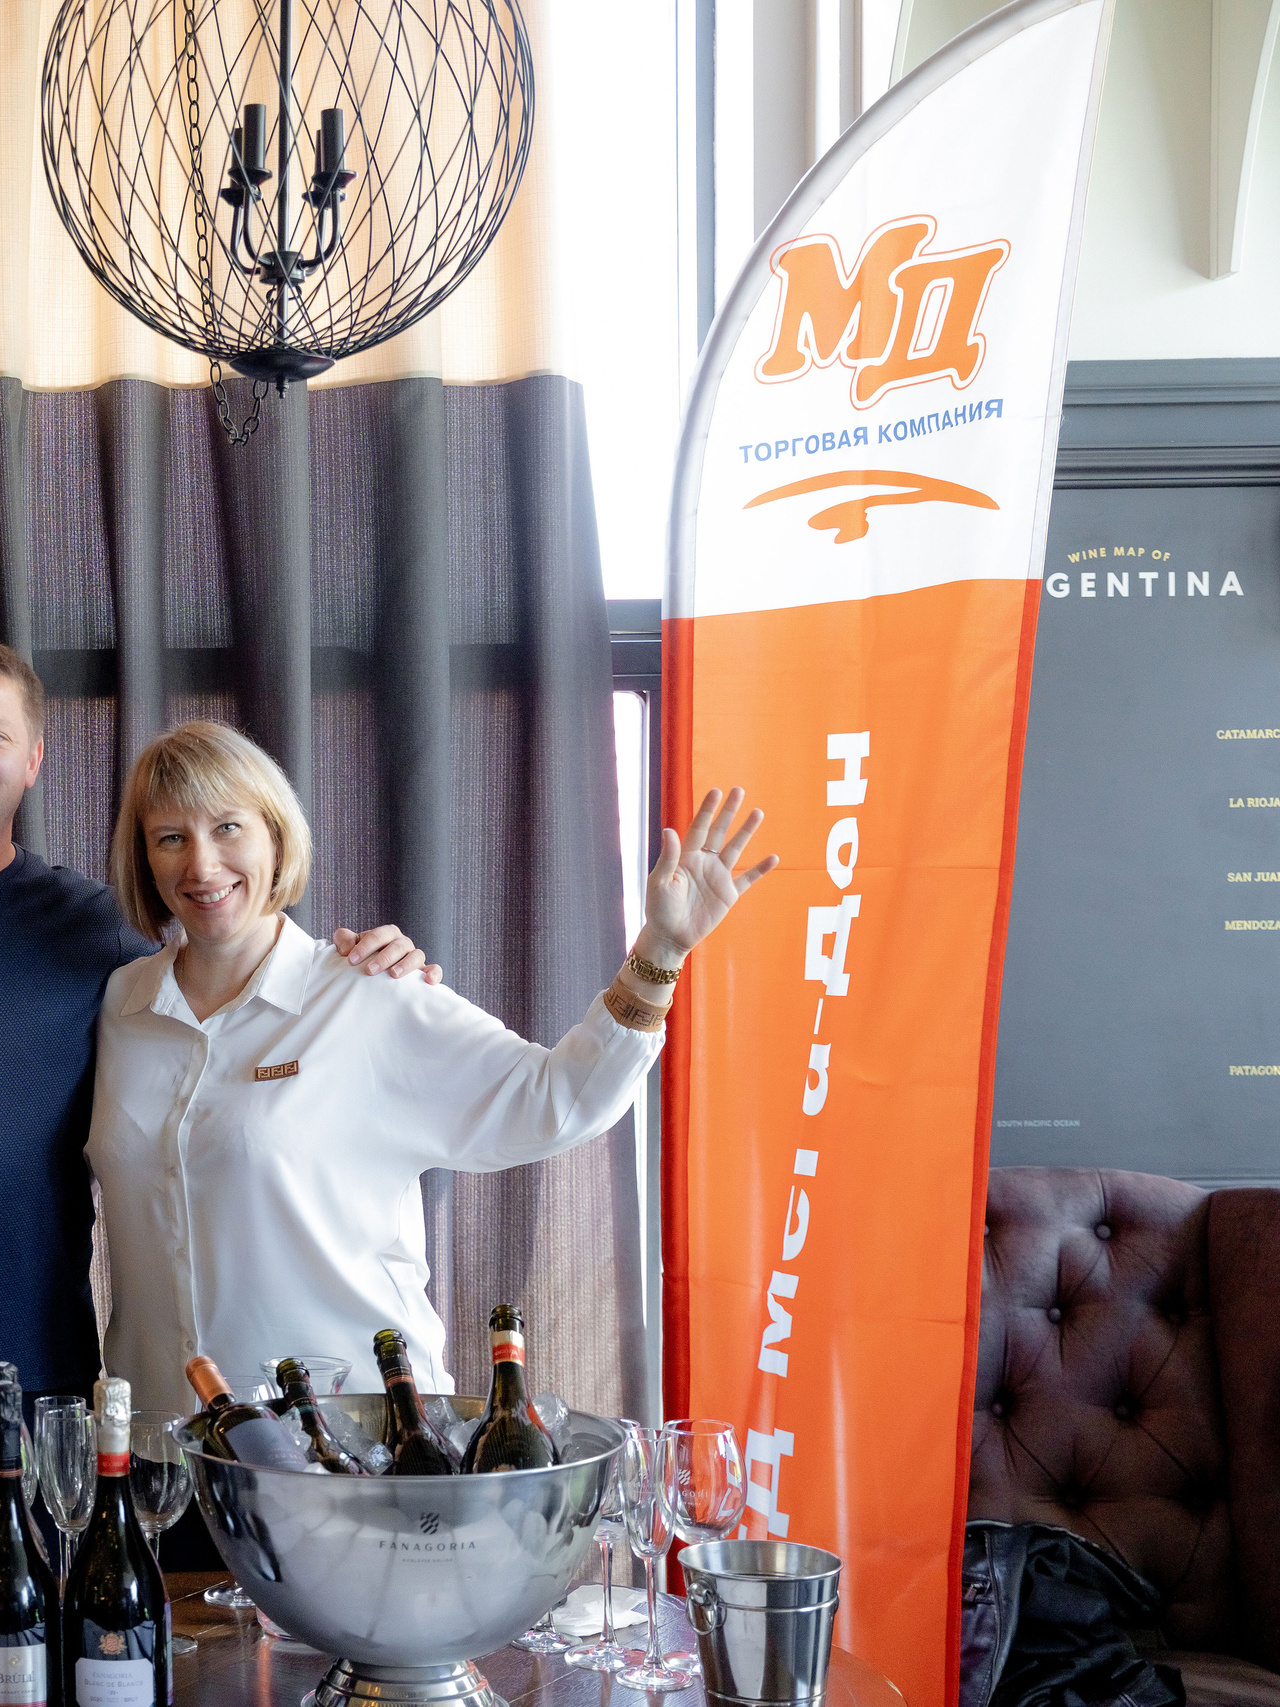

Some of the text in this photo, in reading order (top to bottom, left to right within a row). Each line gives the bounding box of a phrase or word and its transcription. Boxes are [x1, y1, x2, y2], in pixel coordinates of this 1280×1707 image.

[738, 398, 1004, 464] ТОРГОВАЯ КОМПАНИЯ
[1067, 546, 1171, 564] WINE MAP OF
[1045, 571, 1245, 598] GENTINA
[1216, 728, 1280, 740] CATAMARC
[1228, 797, 1280, 808] LA RIOJA
[1227, 871, 1252, 883] SAN
[1228, 1065, 1280, 1076] PATAGON
[1053, 1119, 1080, 1127] OCEAN
[737, 1427, 795, 1541] Д
[379, 1540, 476, 1552] FANAGORIA
